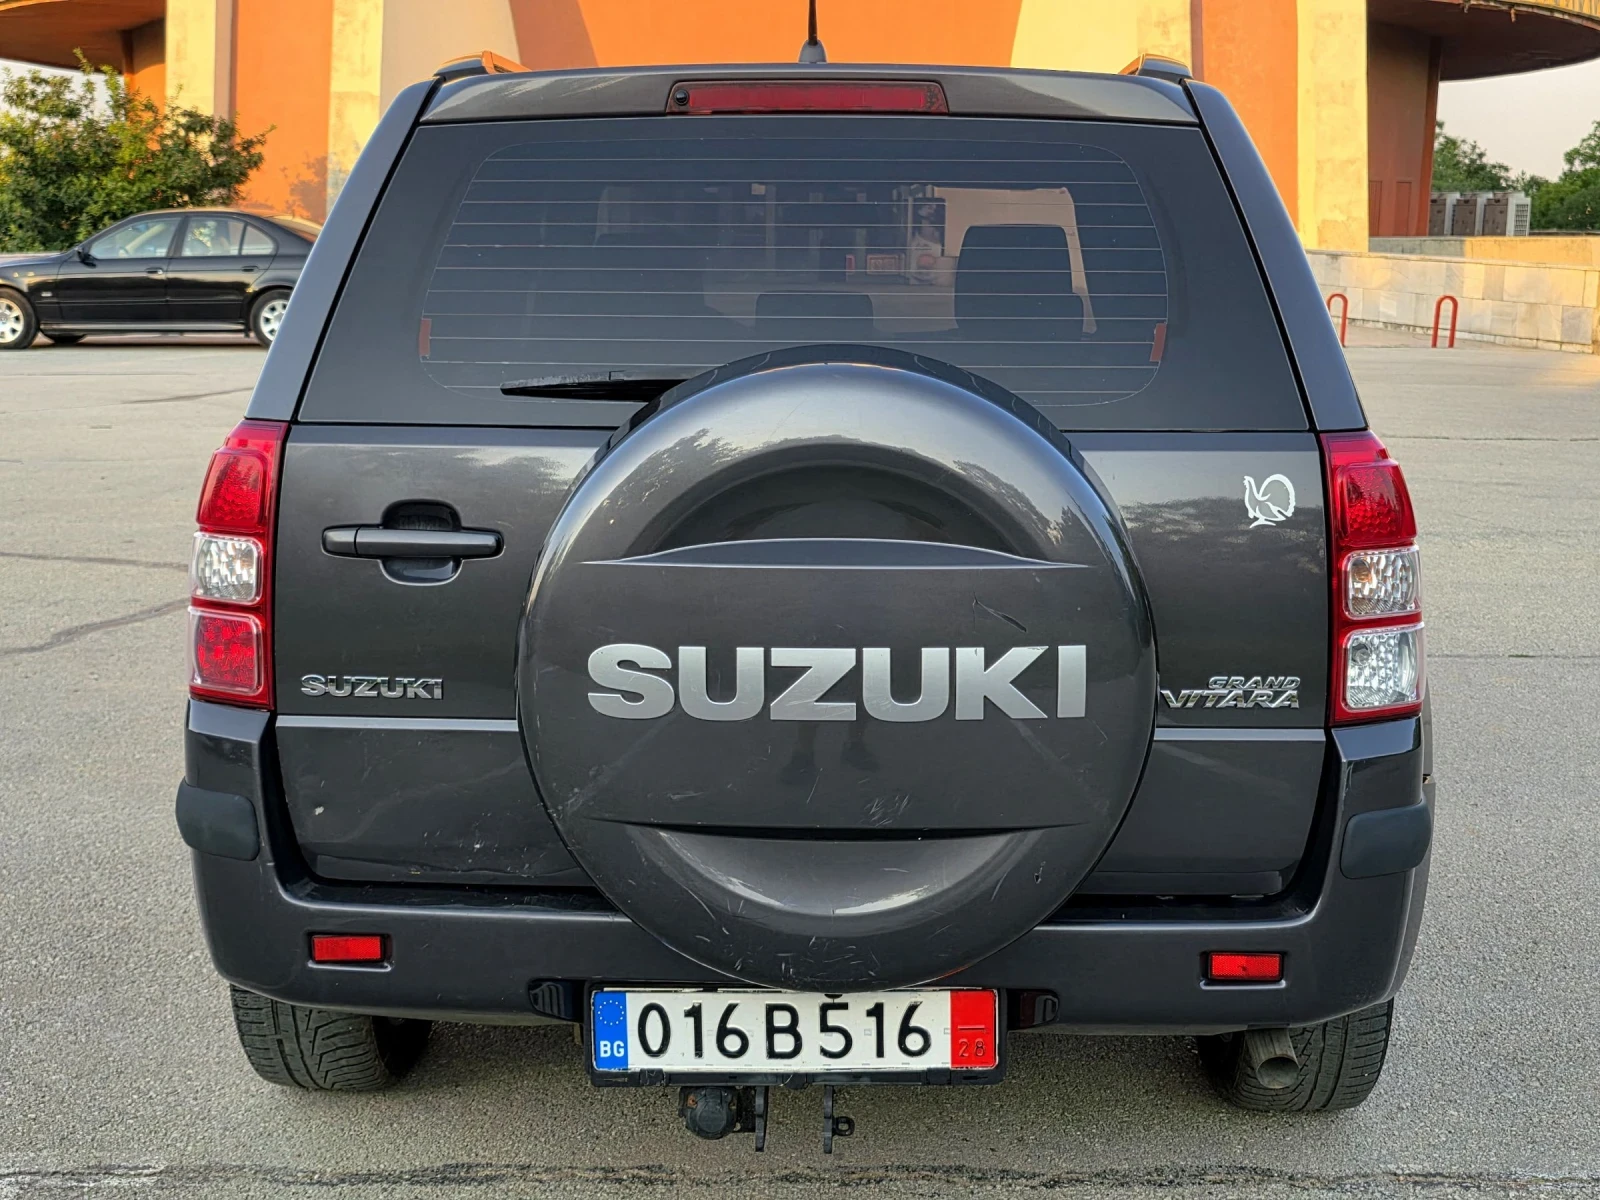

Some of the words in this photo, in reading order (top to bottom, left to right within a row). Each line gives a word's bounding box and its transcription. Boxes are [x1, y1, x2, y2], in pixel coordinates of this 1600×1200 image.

[300, 674, 443, 700] SUZUKI
[587, 643, 1087, 722] SUZUKI
[1208, 676, 1301, 690] GRAND
[1160, 690, 1300, 708] VITARA
[599, 1042, 626, 1058] BG
[958, 1038, 987, 1057] 28
